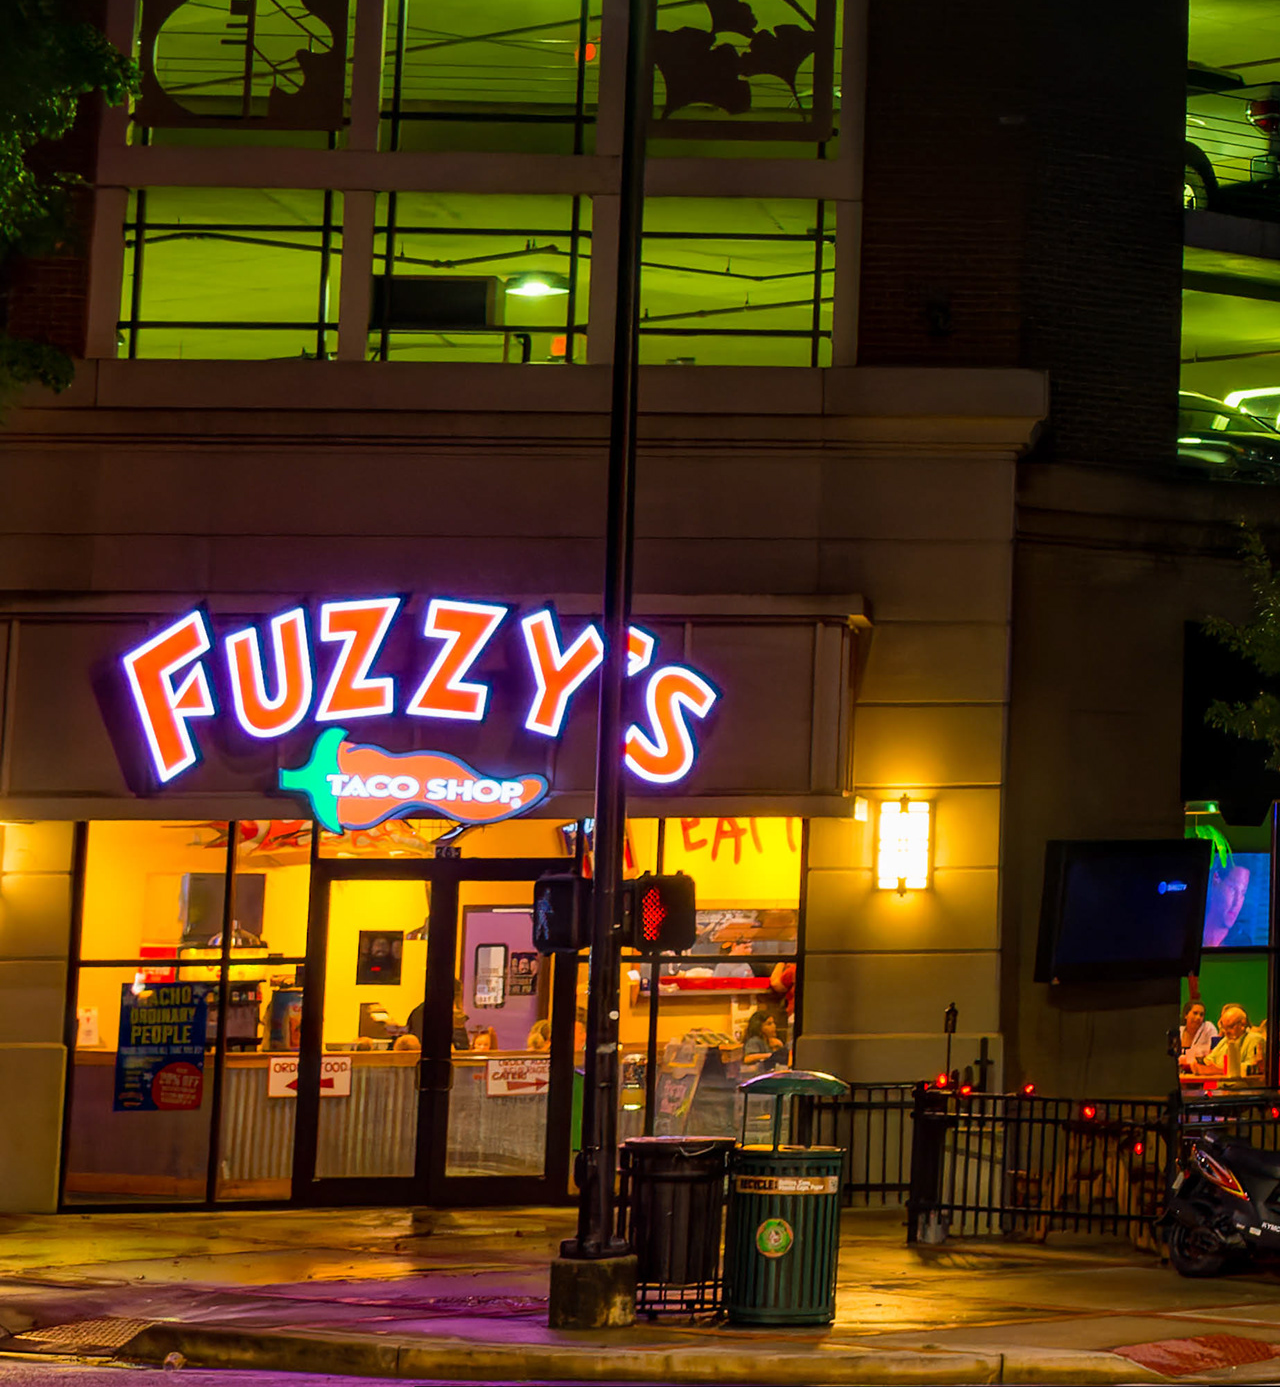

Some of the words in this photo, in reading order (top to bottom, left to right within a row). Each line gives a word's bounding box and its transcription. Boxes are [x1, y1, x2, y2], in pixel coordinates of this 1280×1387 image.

[122, 596, 718, 783] FUZZY'S
[326, 774, 420, 798] TACO
[425, 778, 524, 803] SHOP
[137, 986, 192, 1007] ACHO
[130, 1007, 196, 1026] ORDINARY
[130, 1025, 193, 1045] PEOPLE
